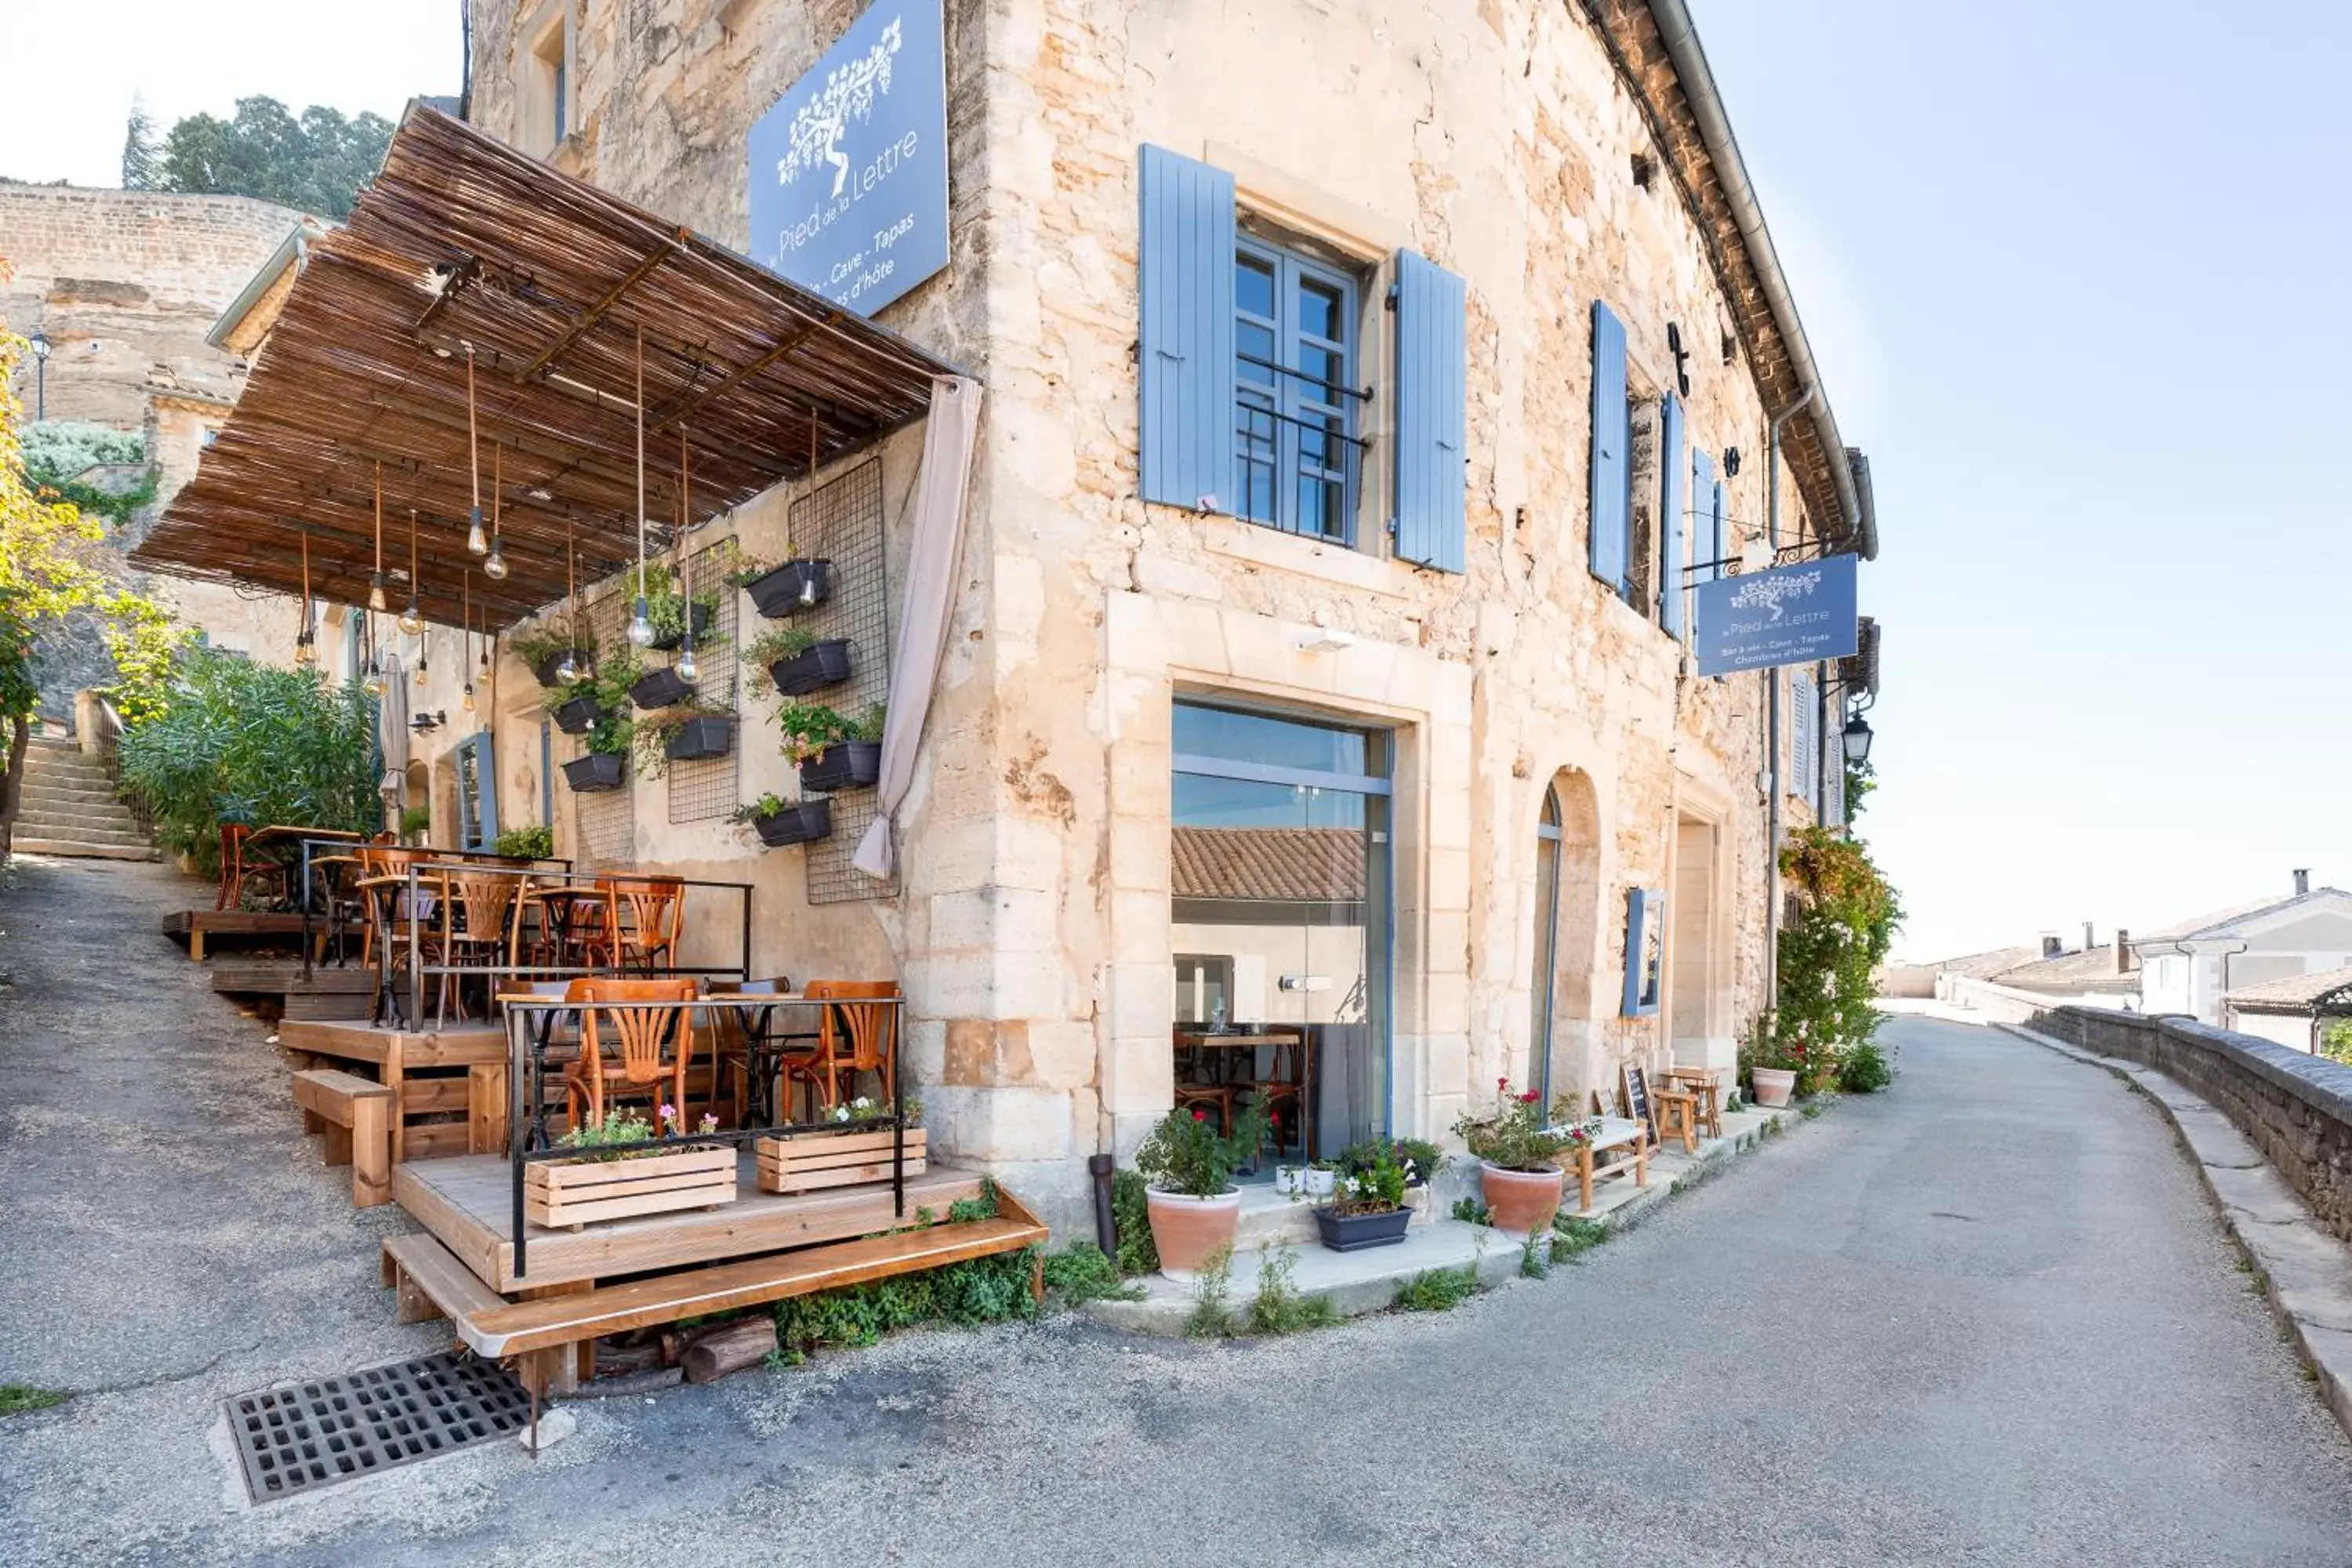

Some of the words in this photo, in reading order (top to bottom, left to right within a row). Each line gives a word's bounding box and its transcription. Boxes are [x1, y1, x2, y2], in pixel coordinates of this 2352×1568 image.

[780, 201, 821, 261] Pied
[823, 208, 837, 225] de
[854, 130, 916, 201] Lettre
[831, 252, 862, 284] Cave
[873, 212, 914, 252] Tapas
[851, 260, 895, 299] d'hôte
[1730, 618, 1762, 634] Pied
[1785, 611, 1830, 627] Lettre
